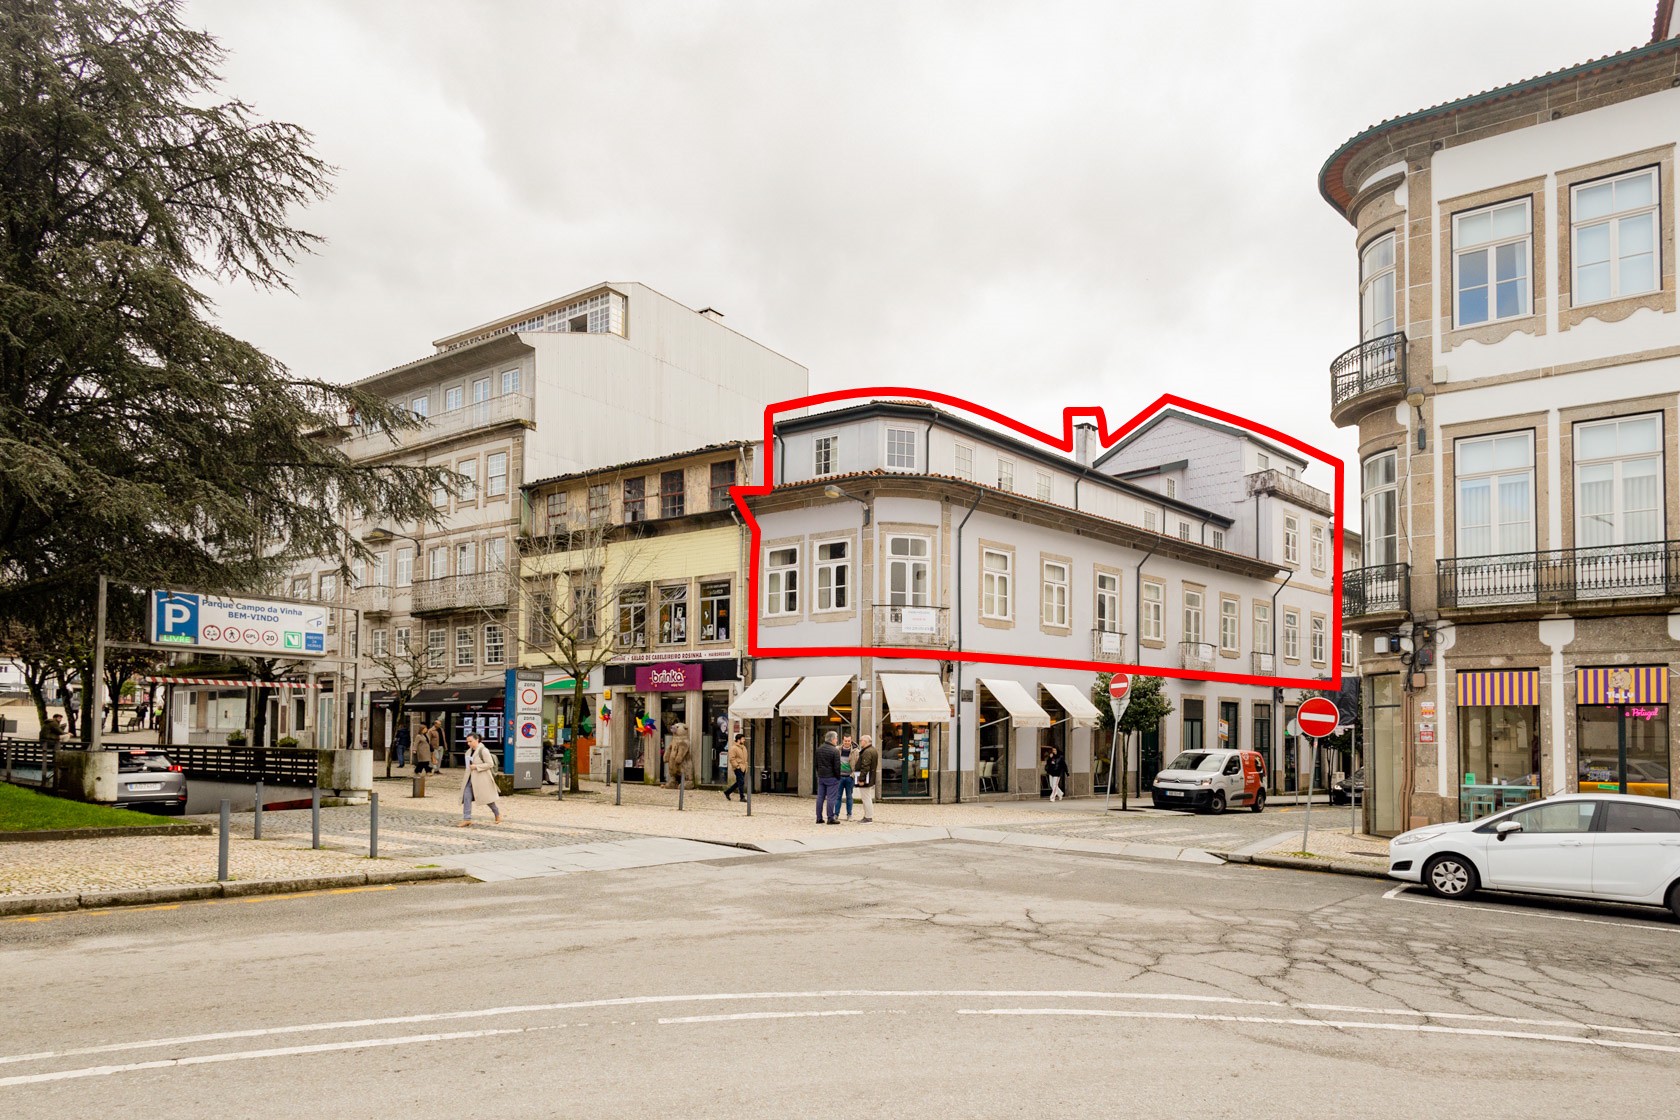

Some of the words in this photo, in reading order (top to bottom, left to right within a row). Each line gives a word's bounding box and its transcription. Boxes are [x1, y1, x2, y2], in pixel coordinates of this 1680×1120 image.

[202, 599, 234, 610] Parque
[236, 602, 265, 613] Campo
[280, 608, 302, 616] Vinha
[164, 602, 191, 632] P
[228, 611, 279, 622] BEM-VINDO
[163, 634, 191, 644] LIVRE
[652, 670, 684, 683] brinka
